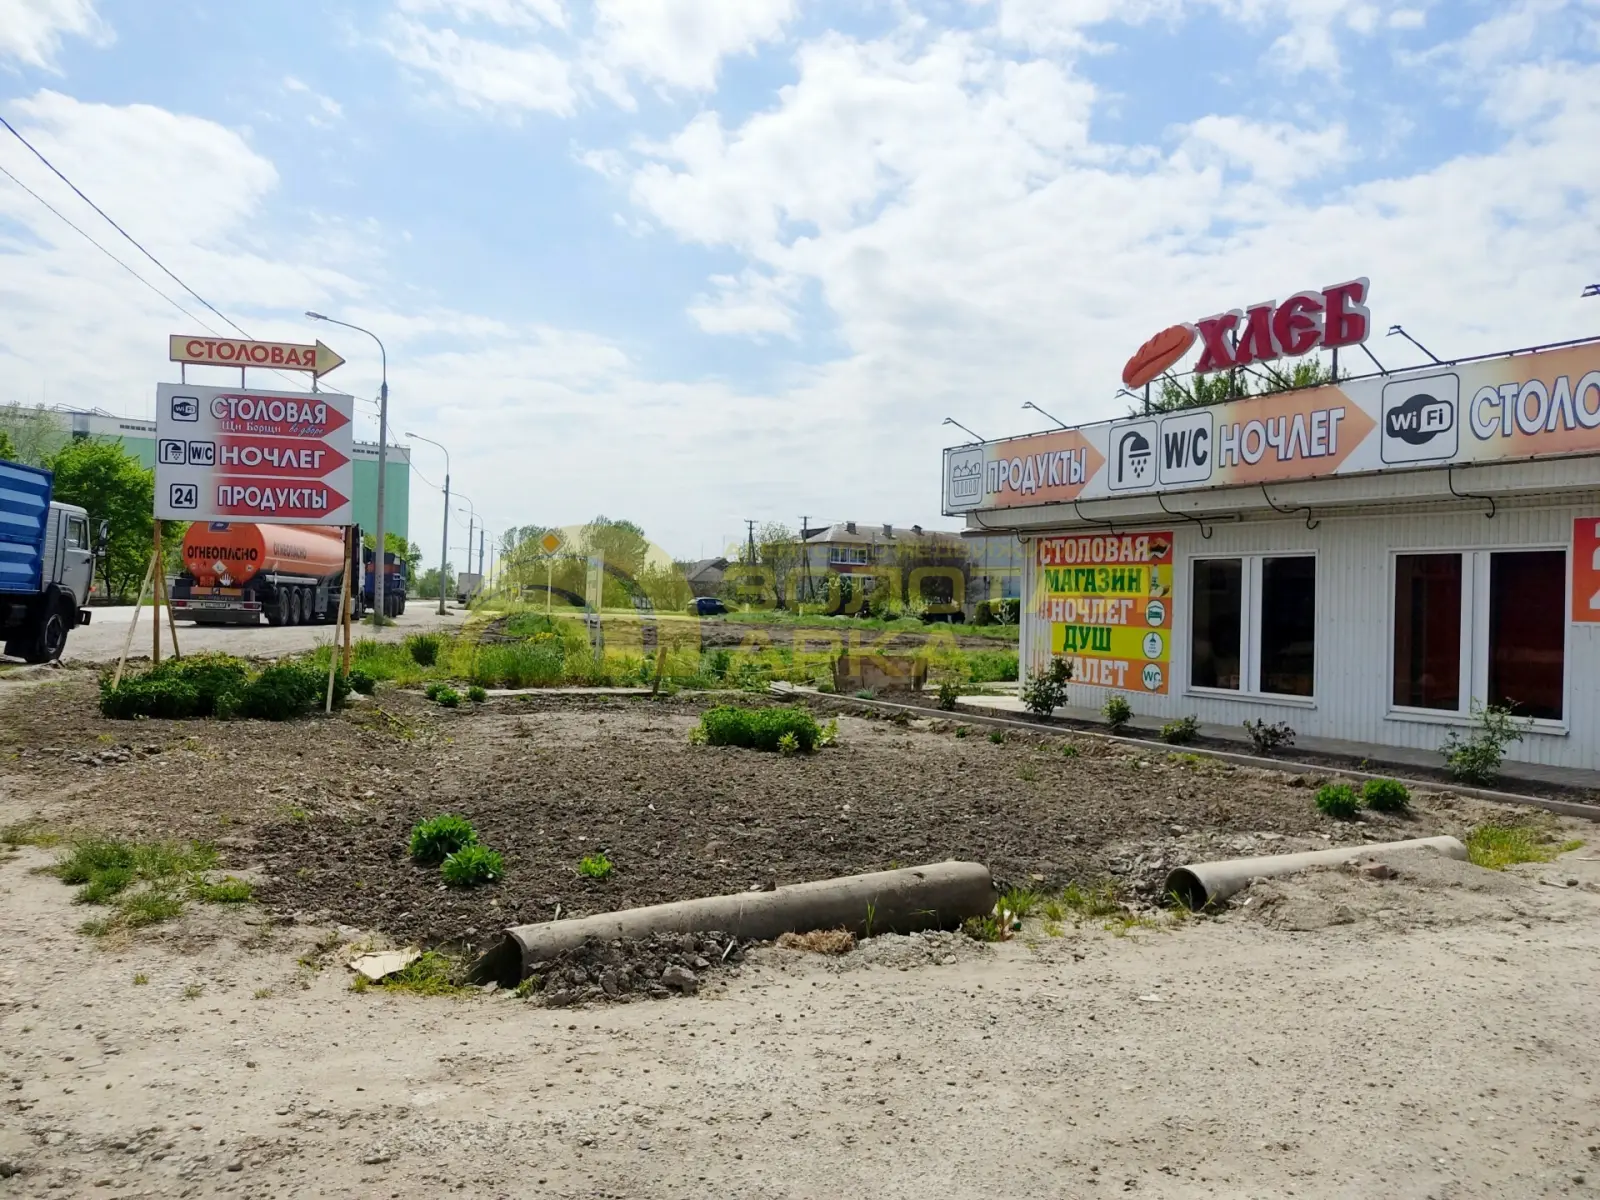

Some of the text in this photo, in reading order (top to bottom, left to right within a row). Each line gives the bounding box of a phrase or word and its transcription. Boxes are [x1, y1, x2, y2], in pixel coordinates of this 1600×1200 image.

[186, 340, 316, 367] СТОЛОВАЯ
[210, 396, 327, 425] СТОЛОВАЯ
[1469, 369, 1600, 441] СТОЛО
[1164, 427, 1208, 470] W/C
[1218, 407, 1346, 468] НОЧЛЕГ
[191, 446, 213, 461] W/C
[220, 445, 326, 469] НОЧЛЕГ
[986, 447, 1086, 494] ПРОДУКТЫ
[174, 488, 193, 505] 24
[217, 485, 327, 511] ПРОДУКТЫ
[187, 545, 258, 561] ОГНЕОПАСНО
[1039, 536, 1150, 564] СТОЛОВАЯ
[1044, 567, 1142, 593] МАГАЗИН
[1050, 598, 1133, 625] НОЧЛЕГ
[1063, 625, 1112, 652] ДУШ
[1064, 656, 1128, 687] АЛЕТ
